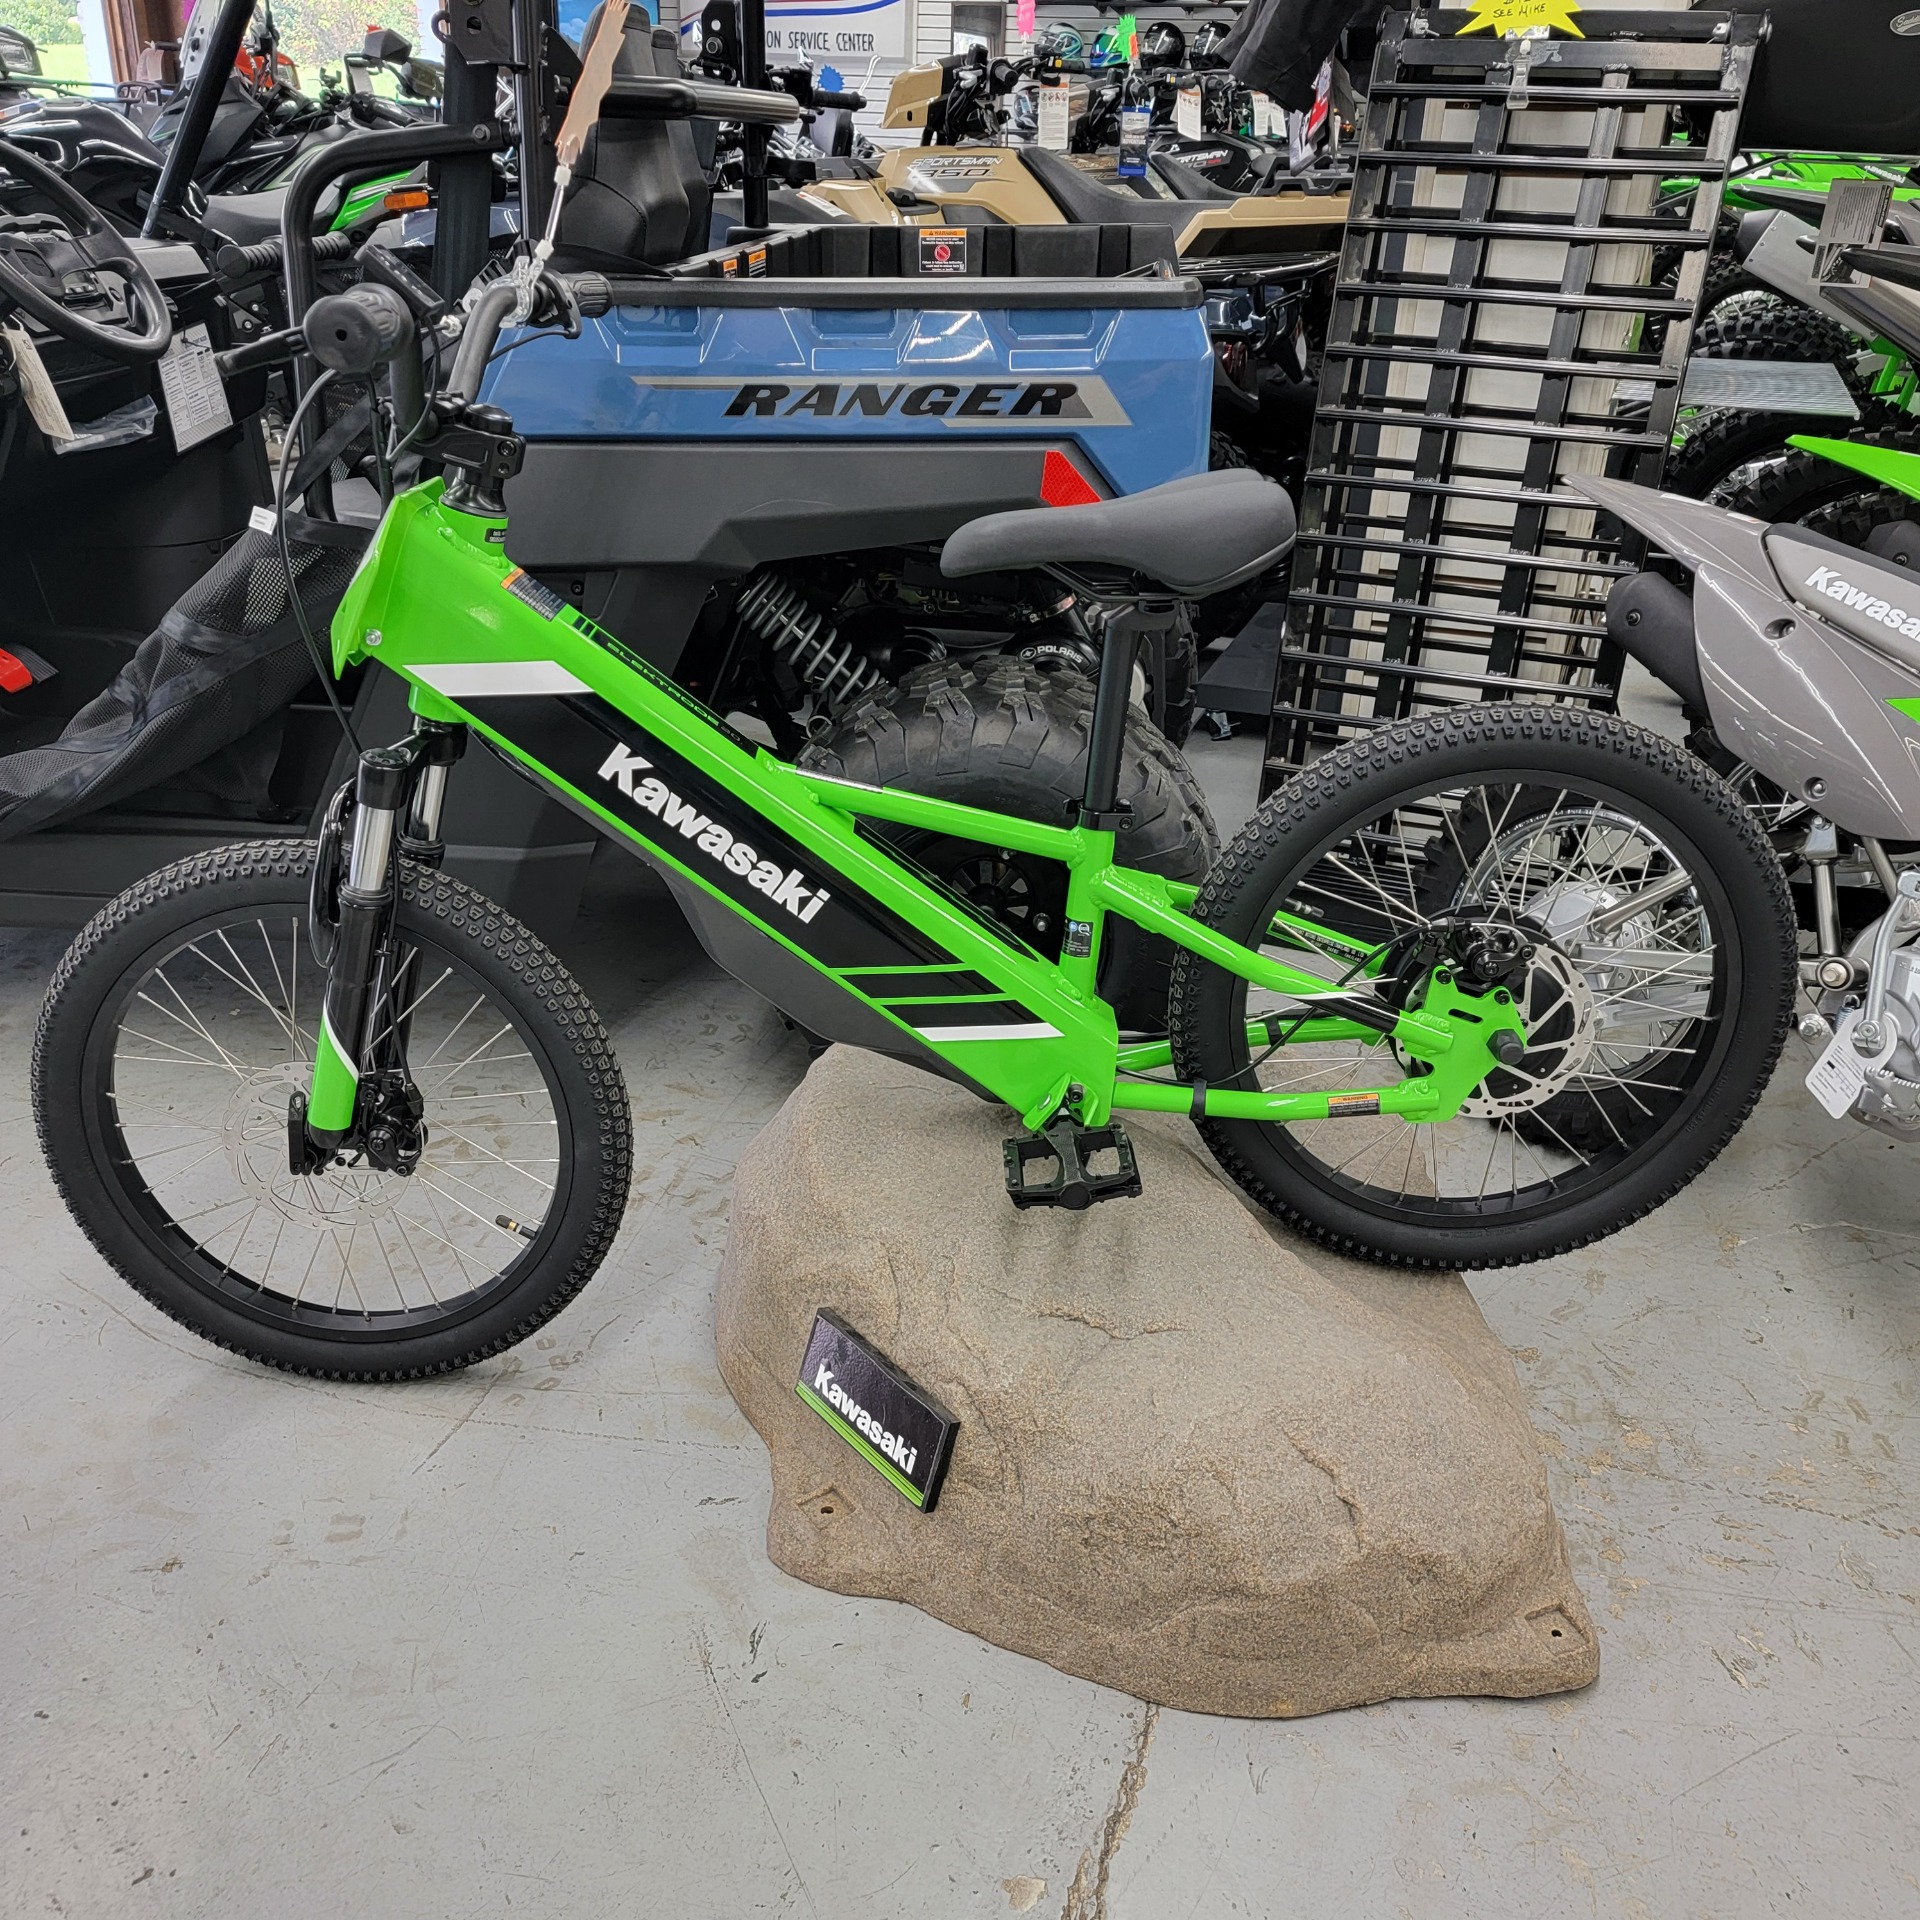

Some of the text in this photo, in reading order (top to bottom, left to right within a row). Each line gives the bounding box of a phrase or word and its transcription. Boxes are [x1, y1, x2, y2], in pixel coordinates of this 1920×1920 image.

[1493, 3, 1546, 18] SEE MIKE
[766, 30, 875, 51] ON SERVICE CENTER
[909, 155, 1004, 167] SPORTSMAN
[1176, 150, 1229, 163] RTSMAN
[721, 383, 1078, 416] RANGER
[1804, 566, 1920, 642] Kawasa
[1037, 645, 1084, 663] POLARIS
[607, 642, 719, 727] ELEKTRODE
[597, 741, 832, 924] Kawasaki
[814, 1363, 917, 1475] Kawasaki
